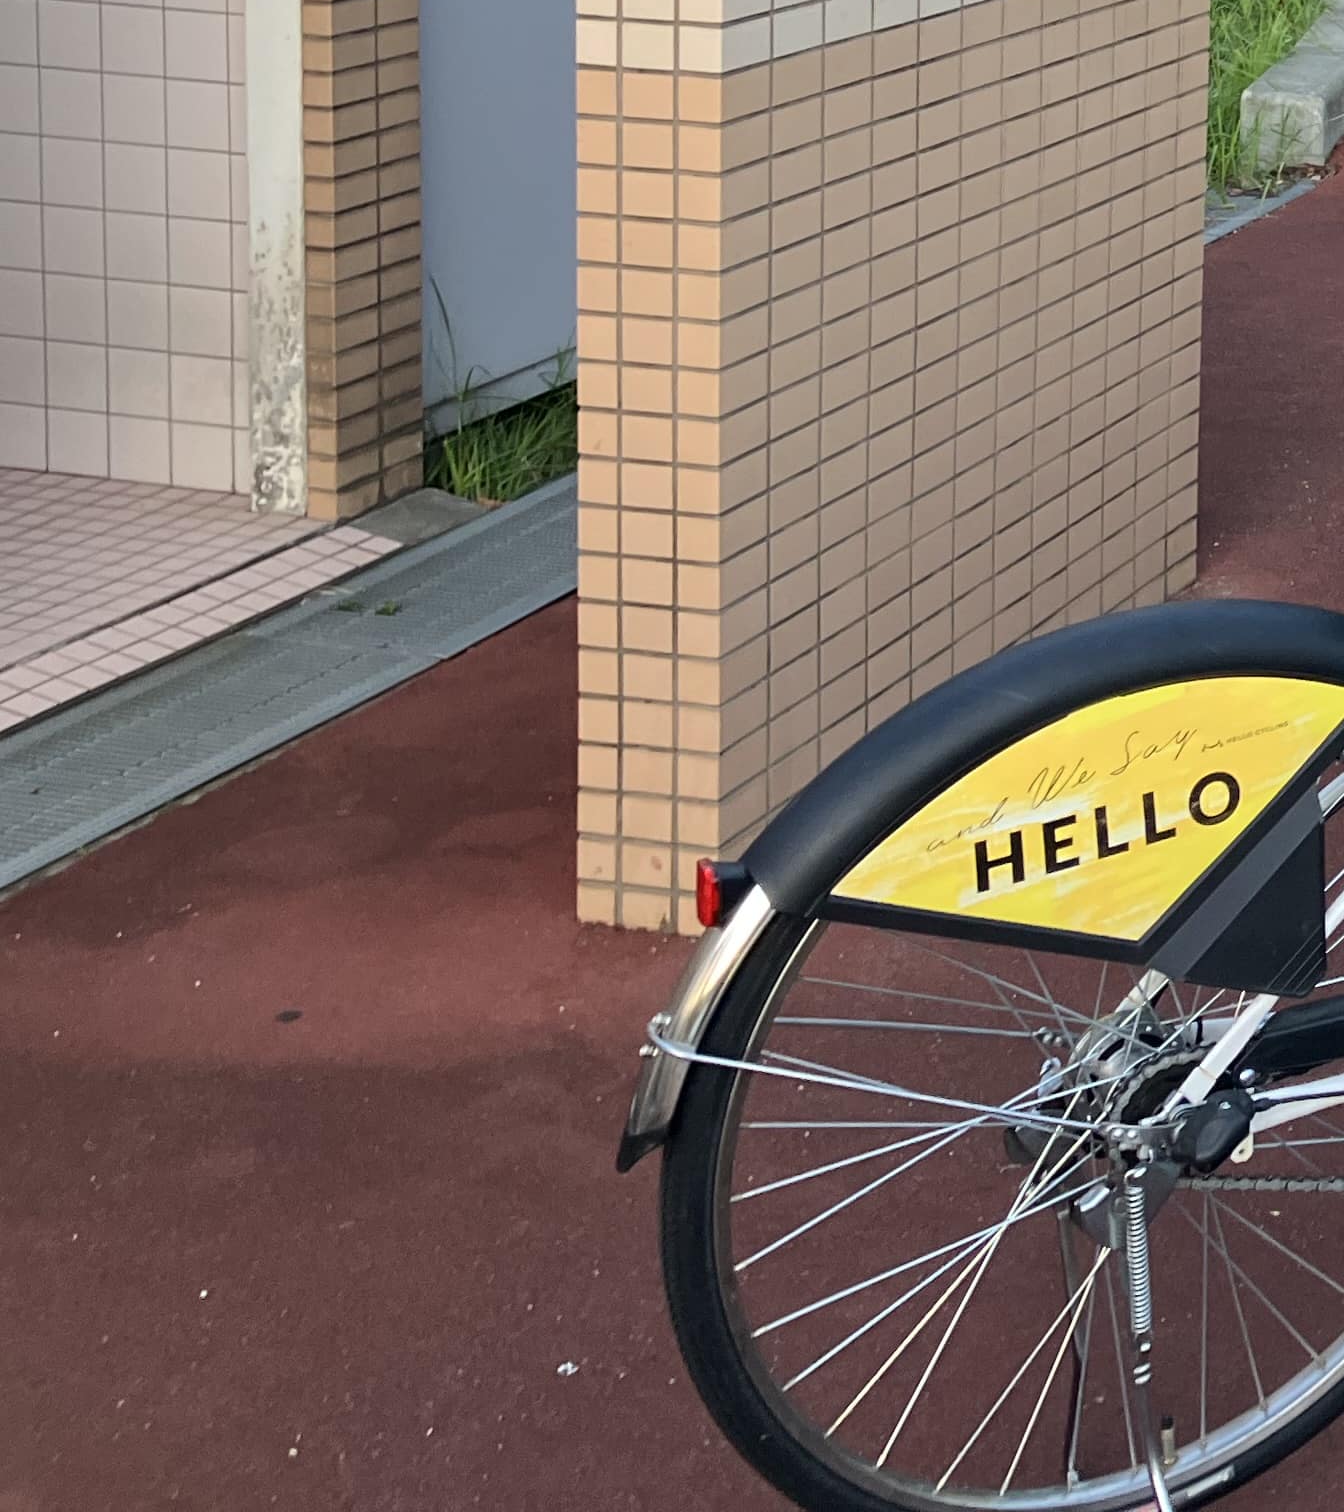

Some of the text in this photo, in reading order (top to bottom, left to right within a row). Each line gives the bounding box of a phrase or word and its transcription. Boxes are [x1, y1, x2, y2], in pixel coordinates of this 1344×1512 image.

[926, 727, 1199, 853] and We Say
[973, 770, 1242, 893] HELLO
